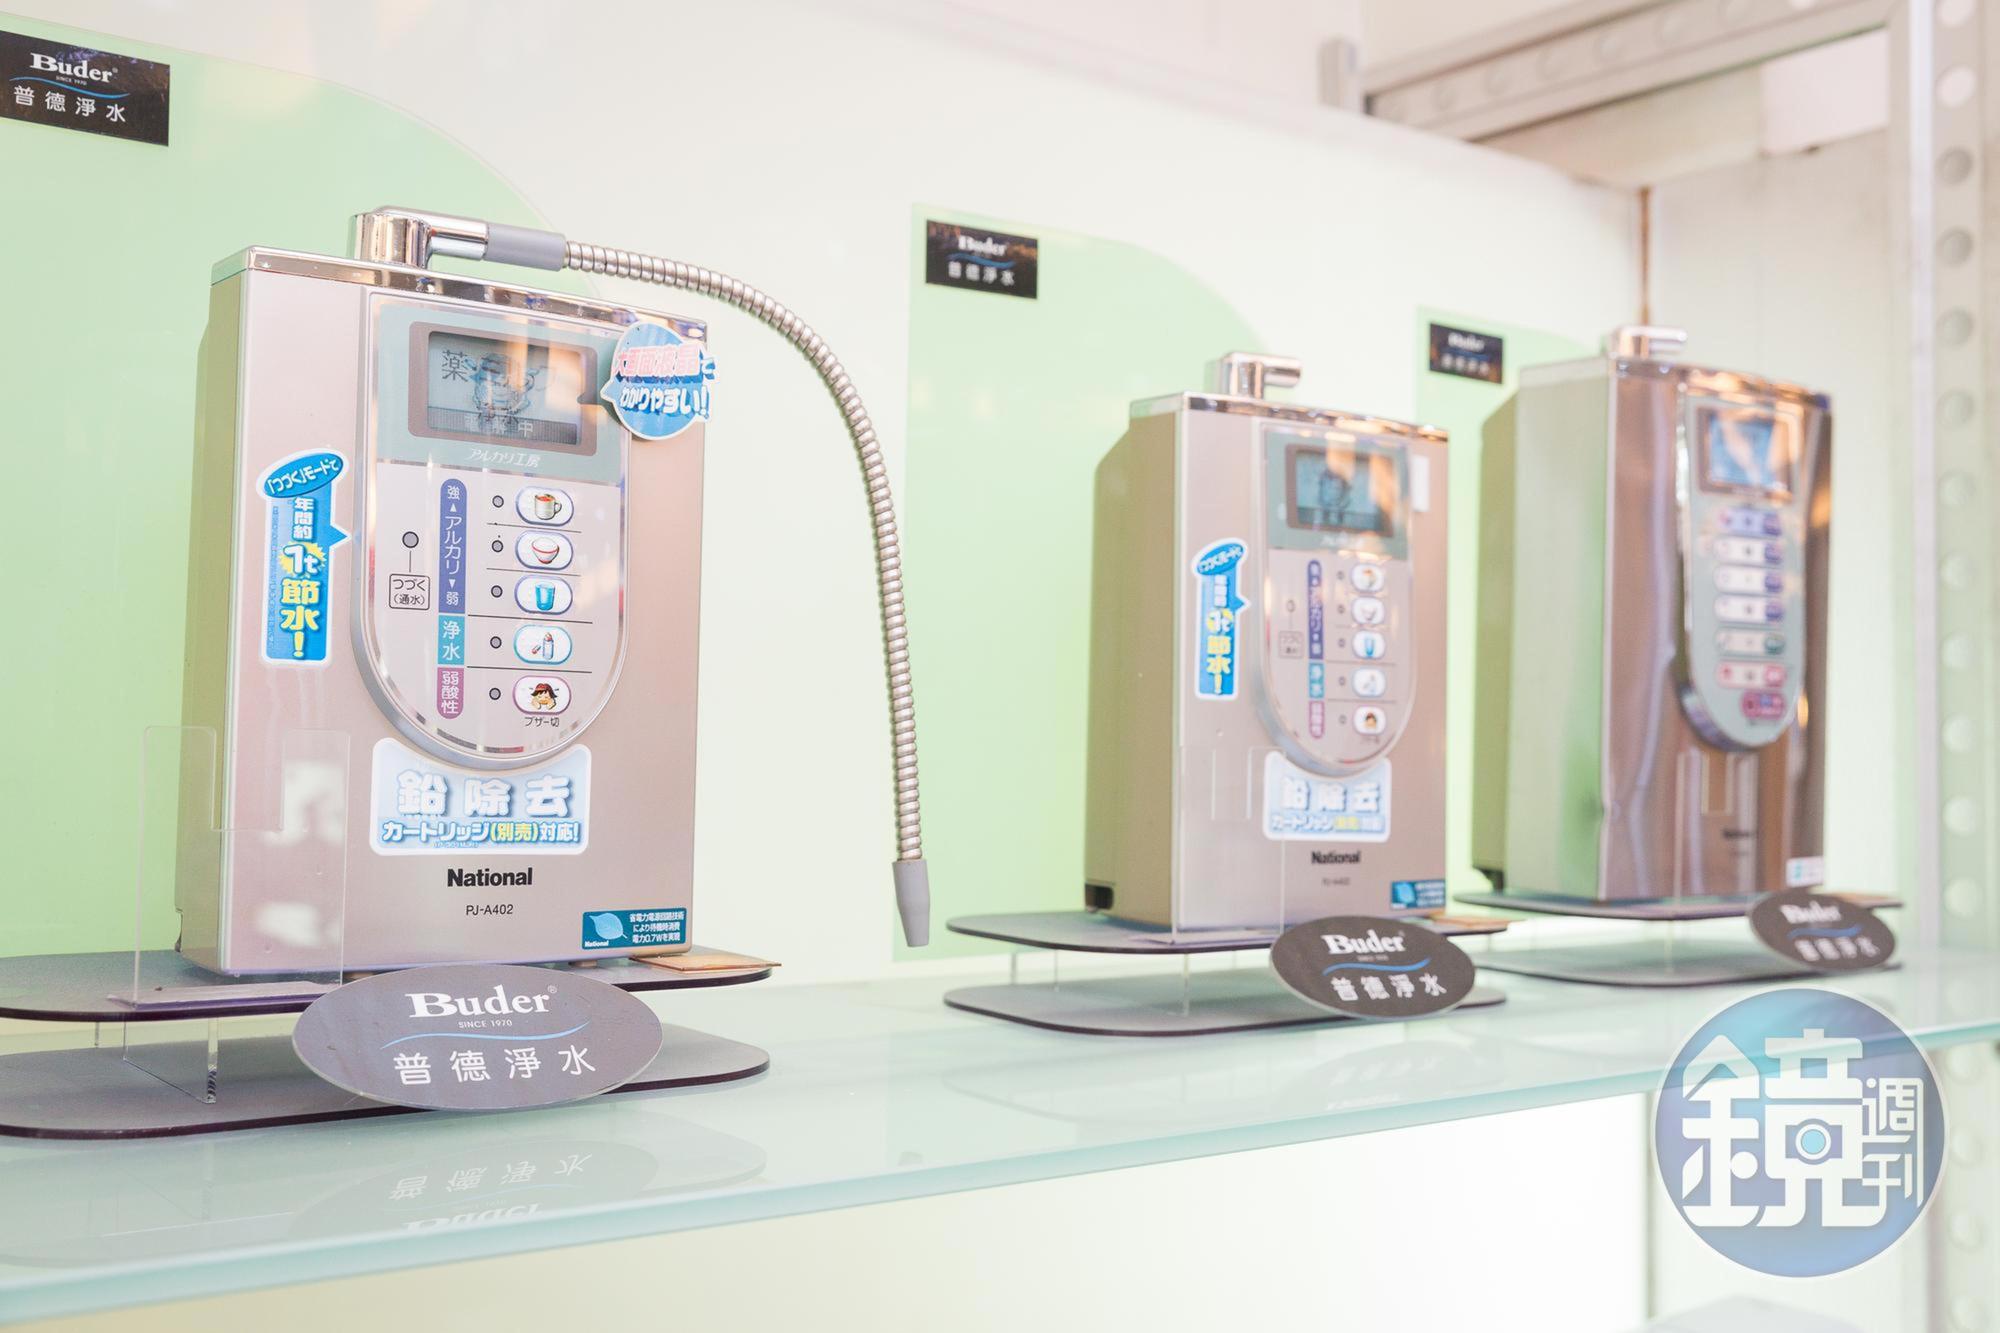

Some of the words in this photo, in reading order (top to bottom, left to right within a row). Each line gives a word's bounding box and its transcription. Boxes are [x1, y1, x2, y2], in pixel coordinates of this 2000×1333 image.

[30, 52, 113, 83] Buder
[14, 85, 127, 123] 普德淨水
[392, 578, 426, 592] つづく
[442, 620, 461, 661] 浄水
[441, 670, 460, 715] 弱酸性
[397, 769, 572, 818] 鉛除去
[1311, 850, 1361, 865] National
[447, 867, 534, 888] National
[465, 904, 514, 916] PJ-A402
[1320, 929, 1407, 954] Buder
[404, 985, 551, 1019] Buder
[458, 1019, 488, 1029] SINCE
[490, 1017, 513, 1028] 1970
[393, 1044, 596, 1086] 普德淨水
